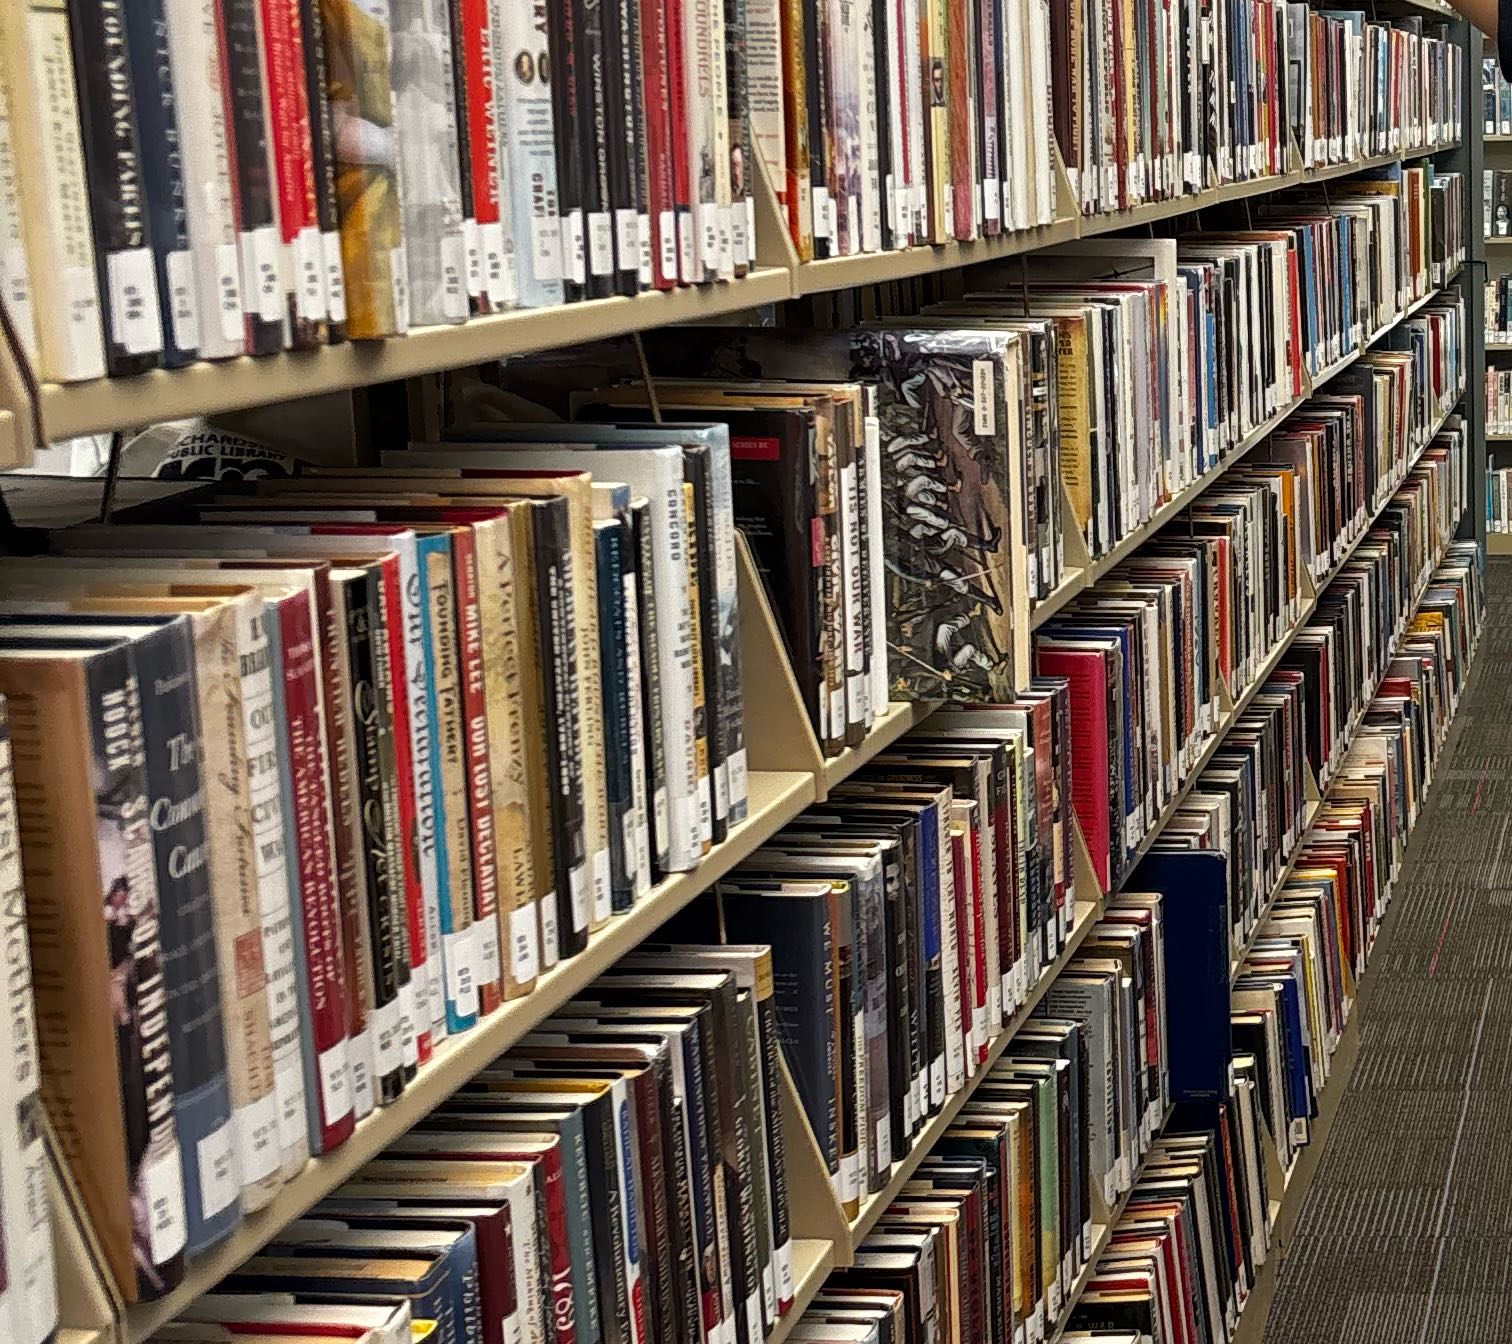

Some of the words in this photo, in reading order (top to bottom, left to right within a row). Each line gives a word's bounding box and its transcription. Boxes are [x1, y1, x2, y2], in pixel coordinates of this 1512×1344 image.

[853, 612, 864, 655] WAR
[102, 689, 131, 770] HOOCK
[823, 961, 834, 1015] MUST
[572, 1134, 589, 1217] REPUBLIC
[583, 1261, 598, 1330] EMPIRE
[610, 1204, 630, 1318] Revolutionary
